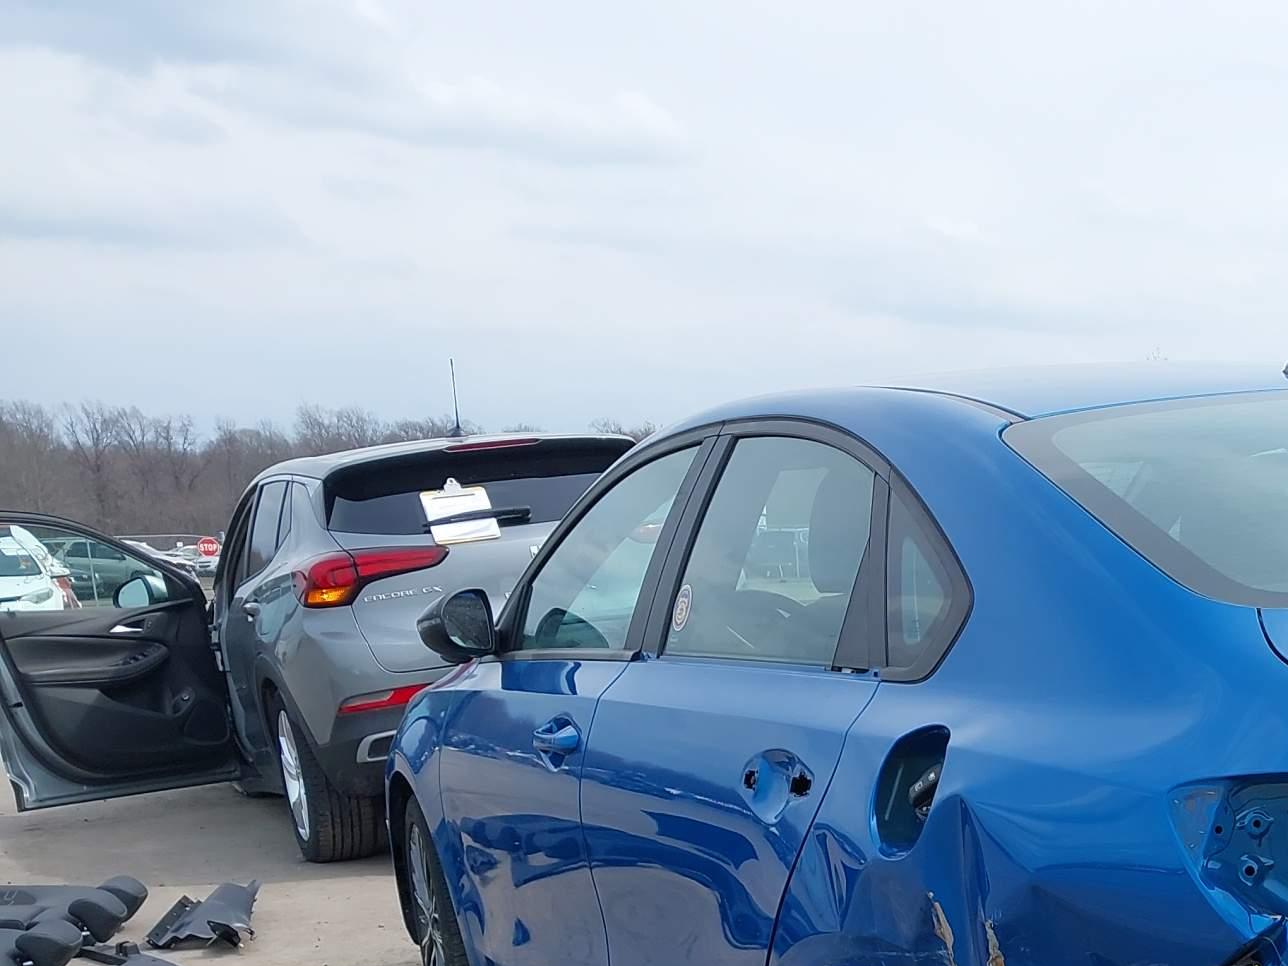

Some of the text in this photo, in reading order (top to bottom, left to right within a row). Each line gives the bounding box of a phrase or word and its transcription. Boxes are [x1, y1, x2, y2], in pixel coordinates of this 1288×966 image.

[200, 543, 217, 551] STOP
[363, 585, 443, 602] ENCORE GX
